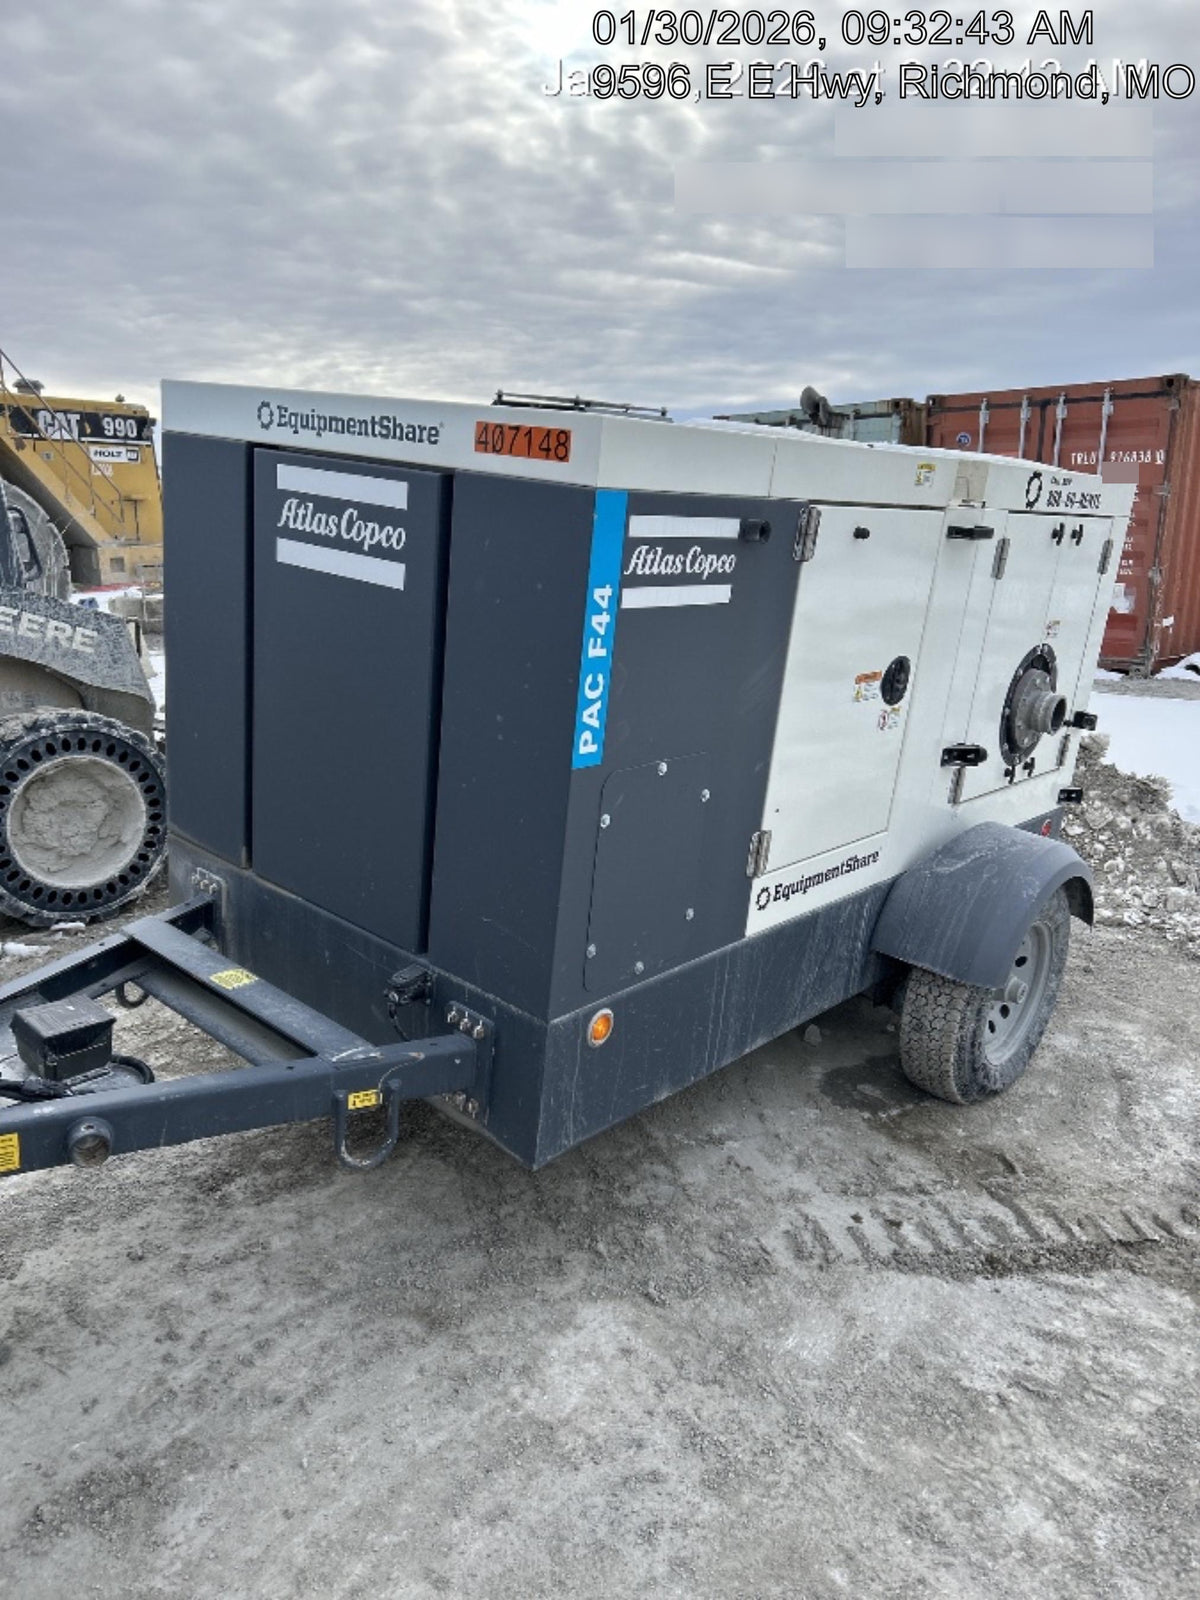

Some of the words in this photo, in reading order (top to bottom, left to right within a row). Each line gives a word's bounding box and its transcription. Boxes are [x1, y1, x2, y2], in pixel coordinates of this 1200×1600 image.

[38, 410, 81, 440] CAT
[102, 417, 138, 438] 990
[277, 404, 440, 445] EquipmentShare
[476, 424, 570, 461] 407148
[93, 449, 123, 458] HOLT
[277, 498, 338, 538] Atlas
[340, 507, 406, 551] Copco
[623, 545, 684, 576] Atlas
[685, 545, 737, 580] Copco
[587, 584, 614, 659] F44
[579, 673, 604, 755] PAC
[772, 850, 880, 902] EquipmentShare
